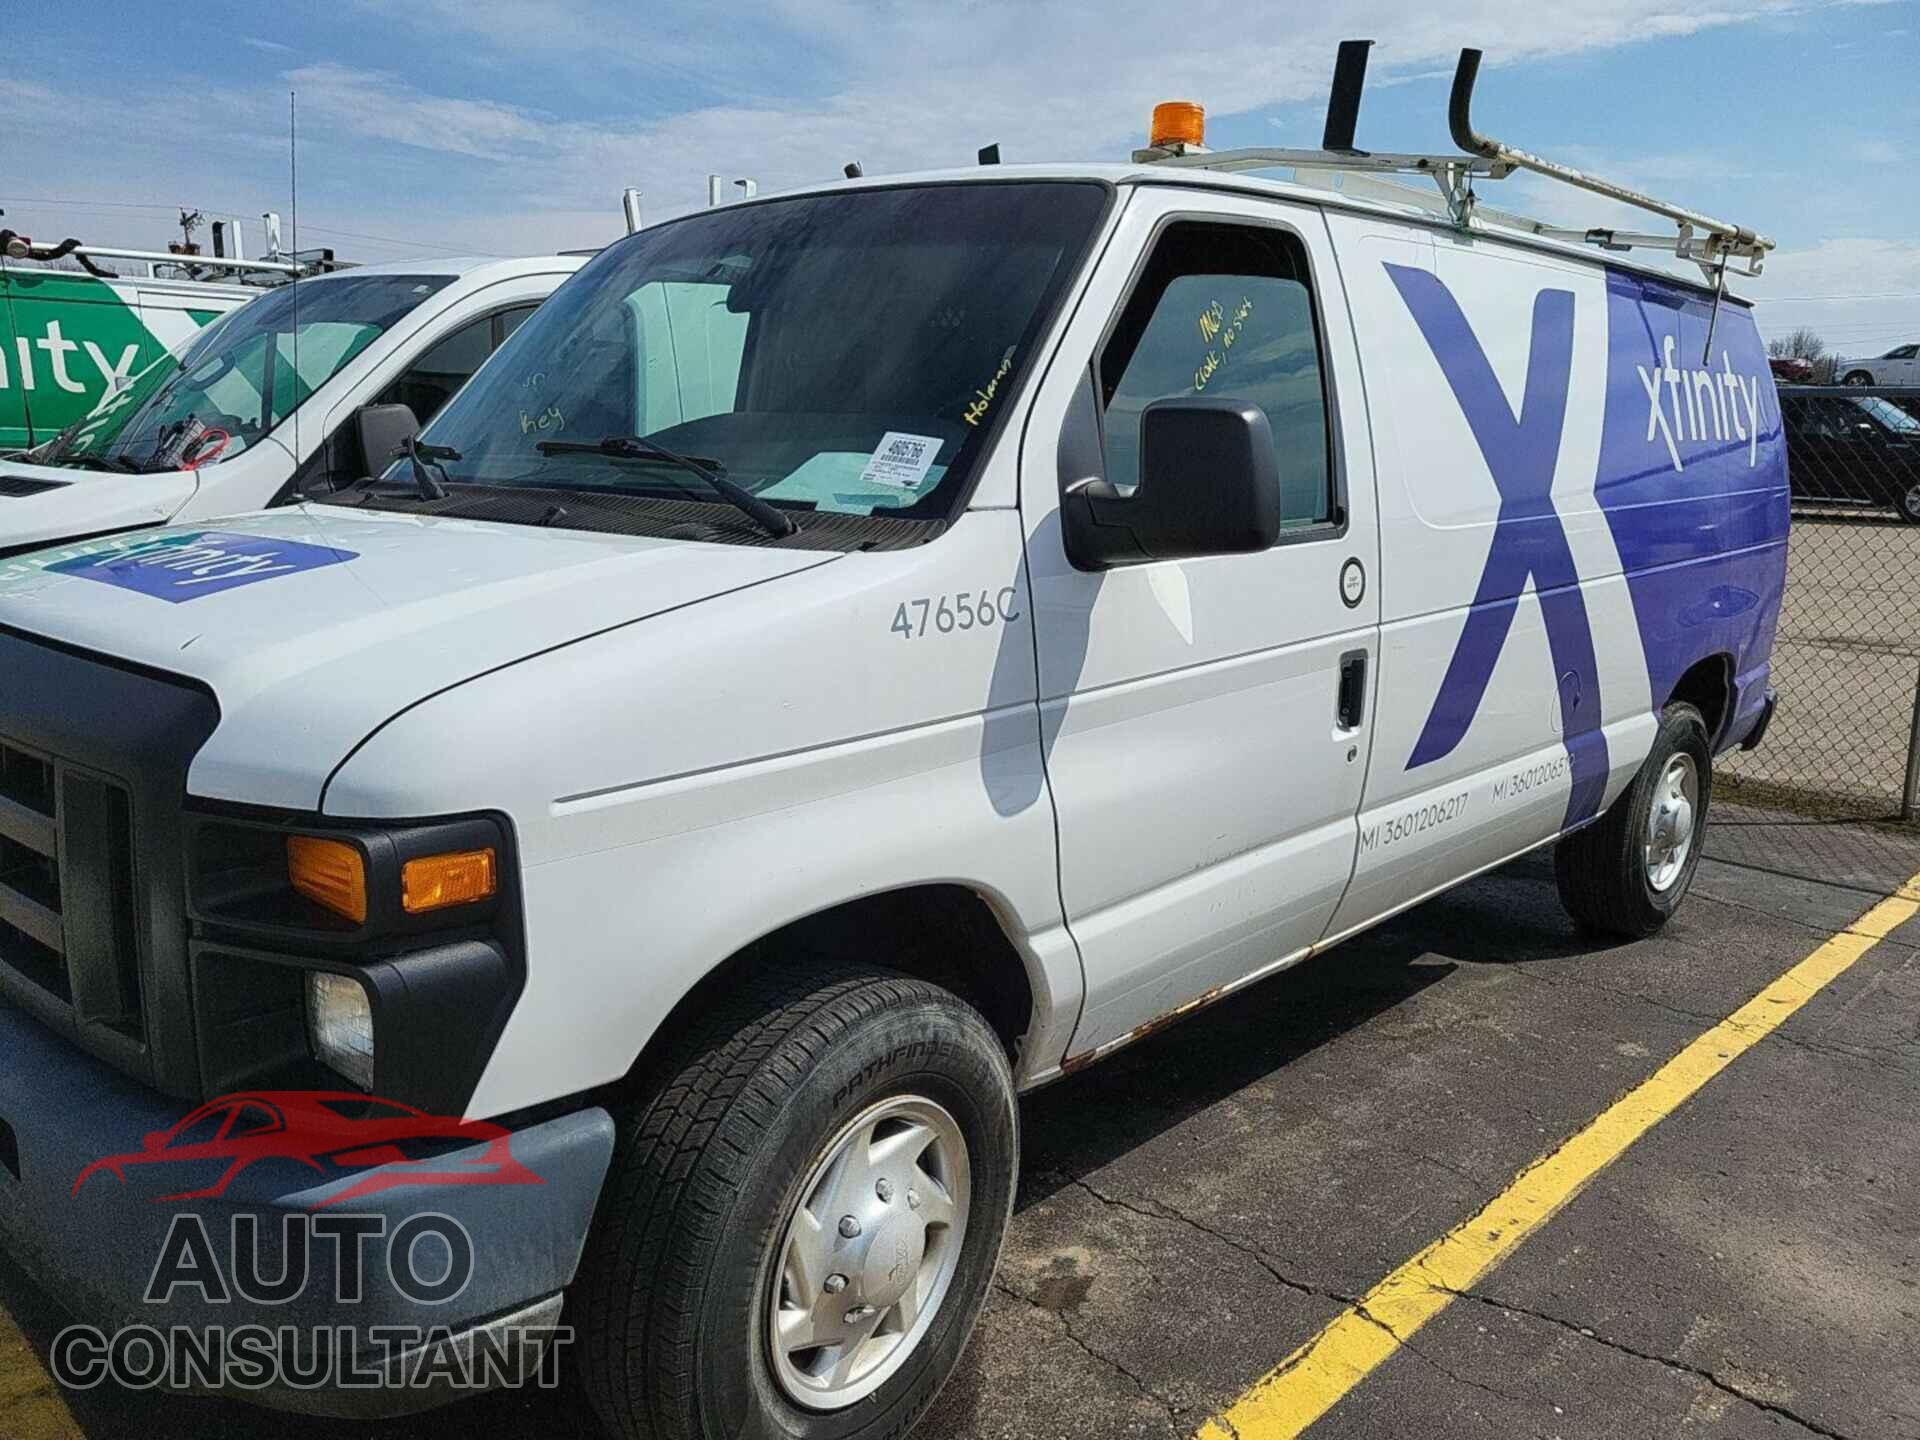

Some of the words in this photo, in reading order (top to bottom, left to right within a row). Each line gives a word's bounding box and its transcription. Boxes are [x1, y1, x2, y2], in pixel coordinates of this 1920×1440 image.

[1637, 335, 1757, 472] xfinity
[890, 586, 1020, 639] 47656C
[1492, 779, 1508, 801] MI
[1360, 826, 1380, 855] MI
[1383, 792, 1469, 845] 3601206217
